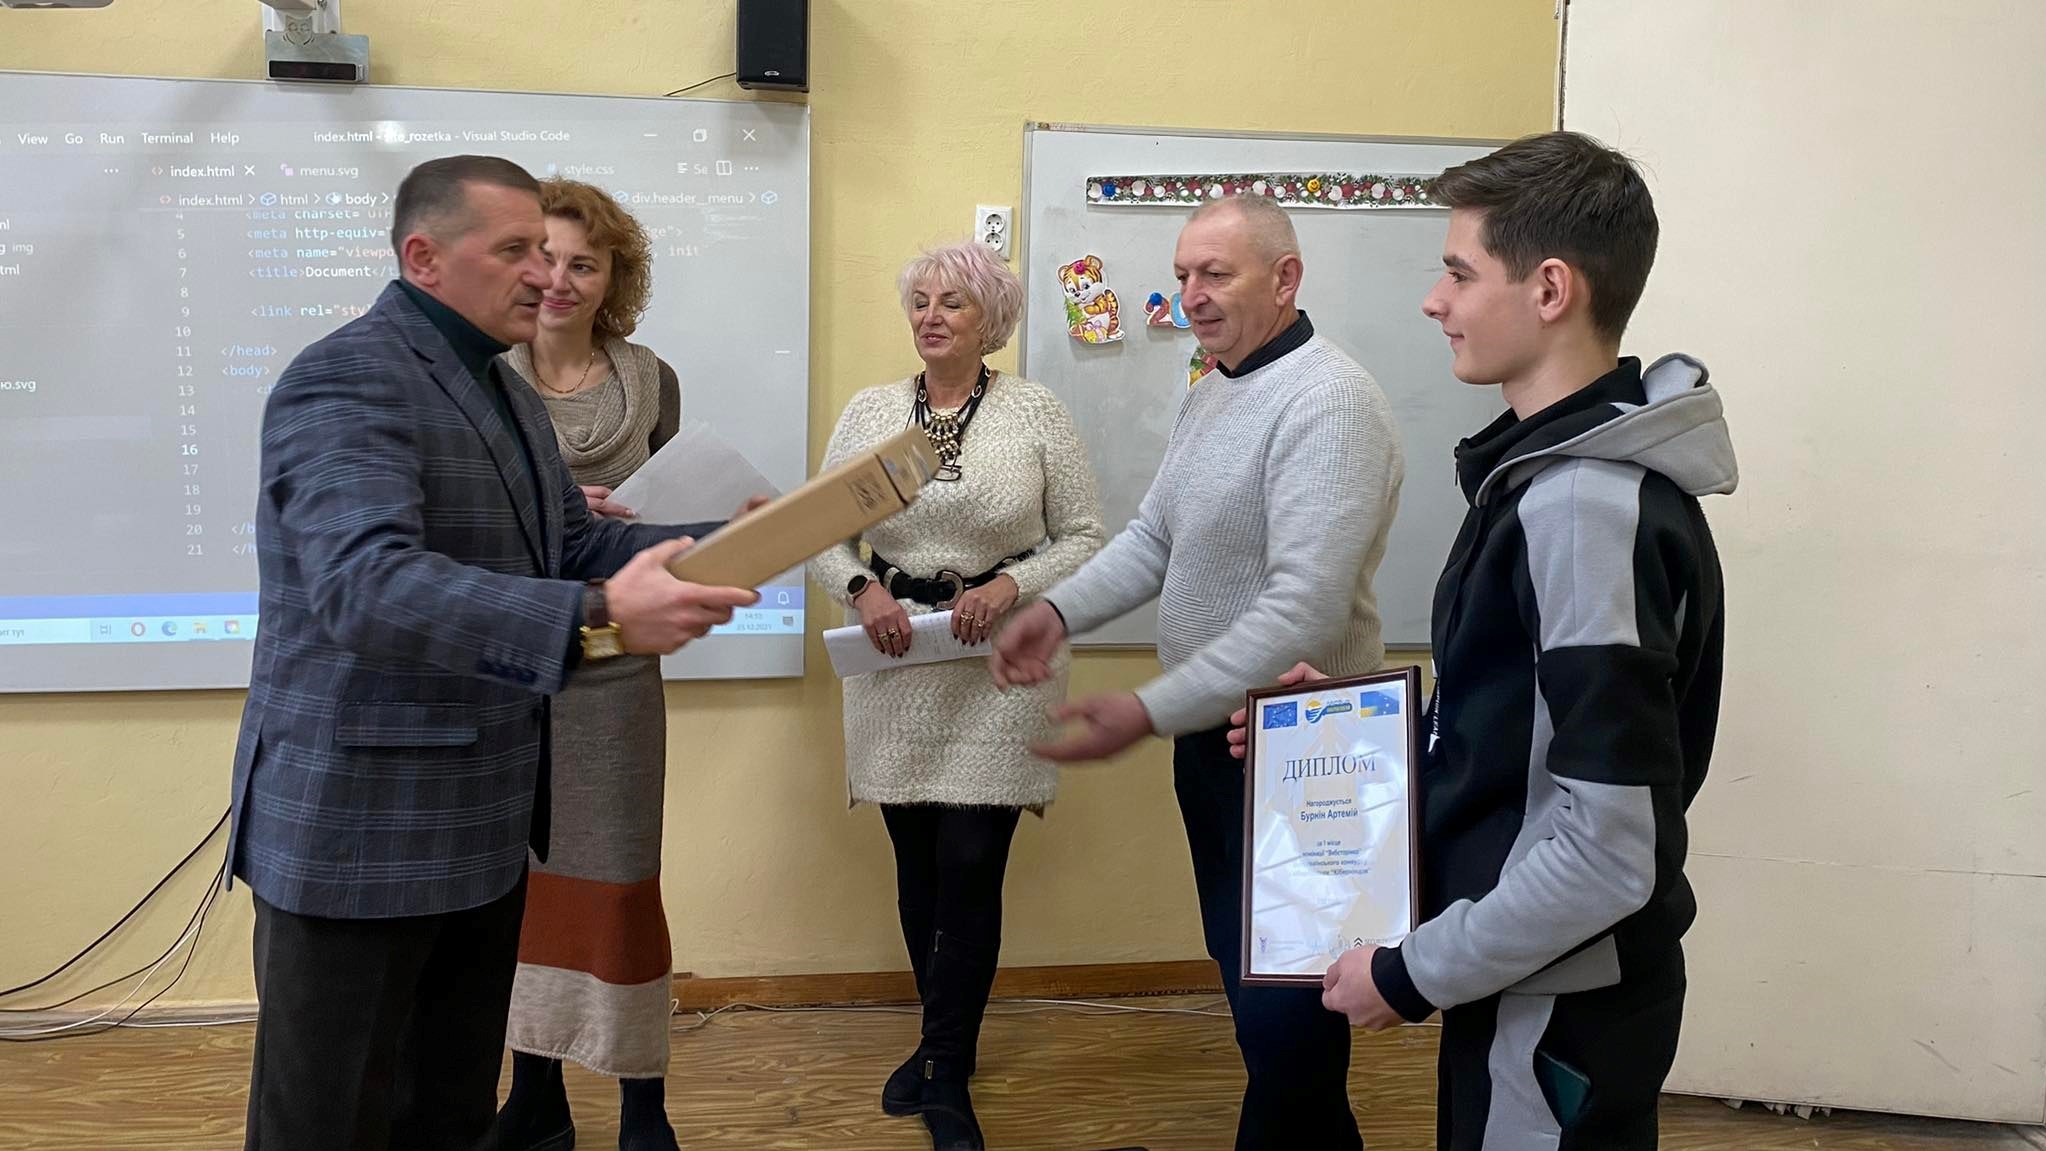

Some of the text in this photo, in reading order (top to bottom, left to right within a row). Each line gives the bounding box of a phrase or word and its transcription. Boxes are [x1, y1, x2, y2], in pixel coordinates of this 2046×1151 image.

[18, 131, 240, 147] View Go Run Terminal Help
[314, 131, 373, 142] index.html
[462, 130, 497, 142] Visual
[500, 130, 537, 142] Studio
[539, 130, 570, 142] Code
[170, 162, 616, 179] index.html menu.svg style.css
[179, 193, 243, 206] index.html
[280, 193, 308, 206] html
[345, 192, 377, 207] body
[177, 229, 185, 240] 5
[247, 228, 288, 240] <meta
[12, 242, 33, 255] img
[178, 248, 187, 259] 6
[247, 247, 289, 259] <meta
[179, 267, 187, 278] 7
[180, 287, 189, 298] 8
[181, 306, 190, 318] 9
[251, 304, 292, 317] <link
[175, 325, 191, 337] 10
[176, 343, 278, 357] 11 </head>
[177, 363, 271, 378] 12 <body>
[178, 384, 195, 397] 13
[180, 404, 195, 416] 14
[181, 424, 197, 436] 15
[182, 443, 198, 456] 16
[183, 463, 199, 475] 17
[184, 483, 200, 496] 18
[185, 503, 201, 516] 19
[186, 523, 202, 536] 20
[187, 543, 204, 556] 21
[1282, 756, 1377, 784] ДИПЛОМ
